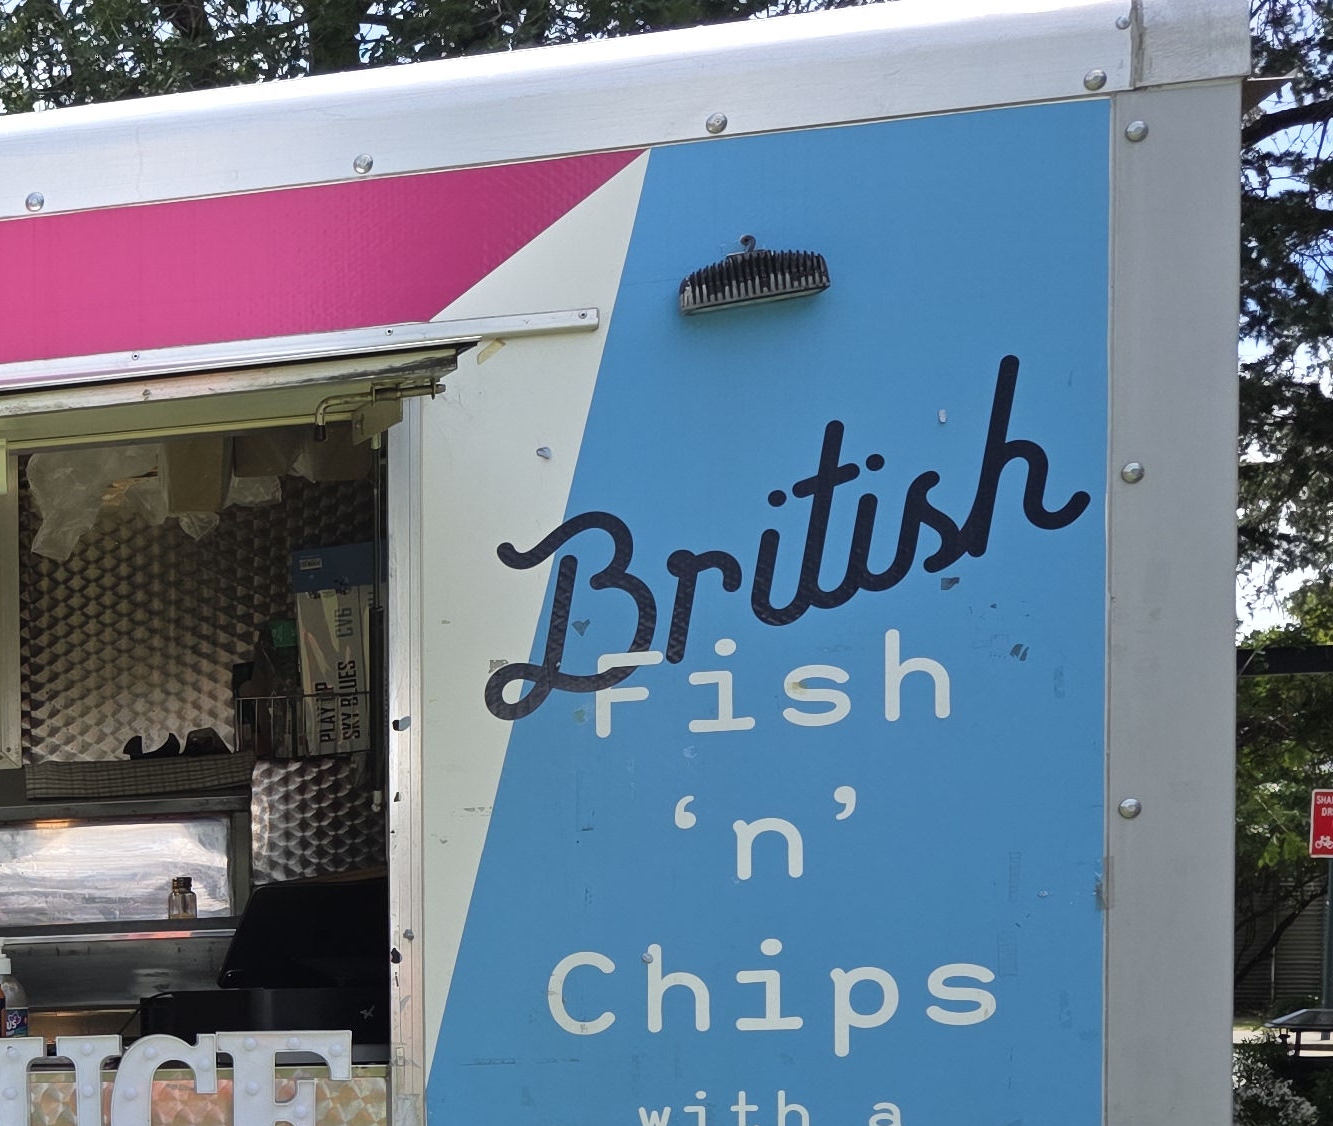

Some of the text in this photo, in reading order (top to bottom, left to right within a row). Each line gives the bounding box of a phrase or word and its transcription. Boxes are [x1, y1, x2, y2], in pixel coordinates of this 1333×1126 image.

[484, 355, 1090, 721] British
[318, 707, 336, 743] PLAY
[341, 712, 361, 740] SKY
[593, 628, 951, 739] Fish
[547, 938, 998, 1057] Chips
